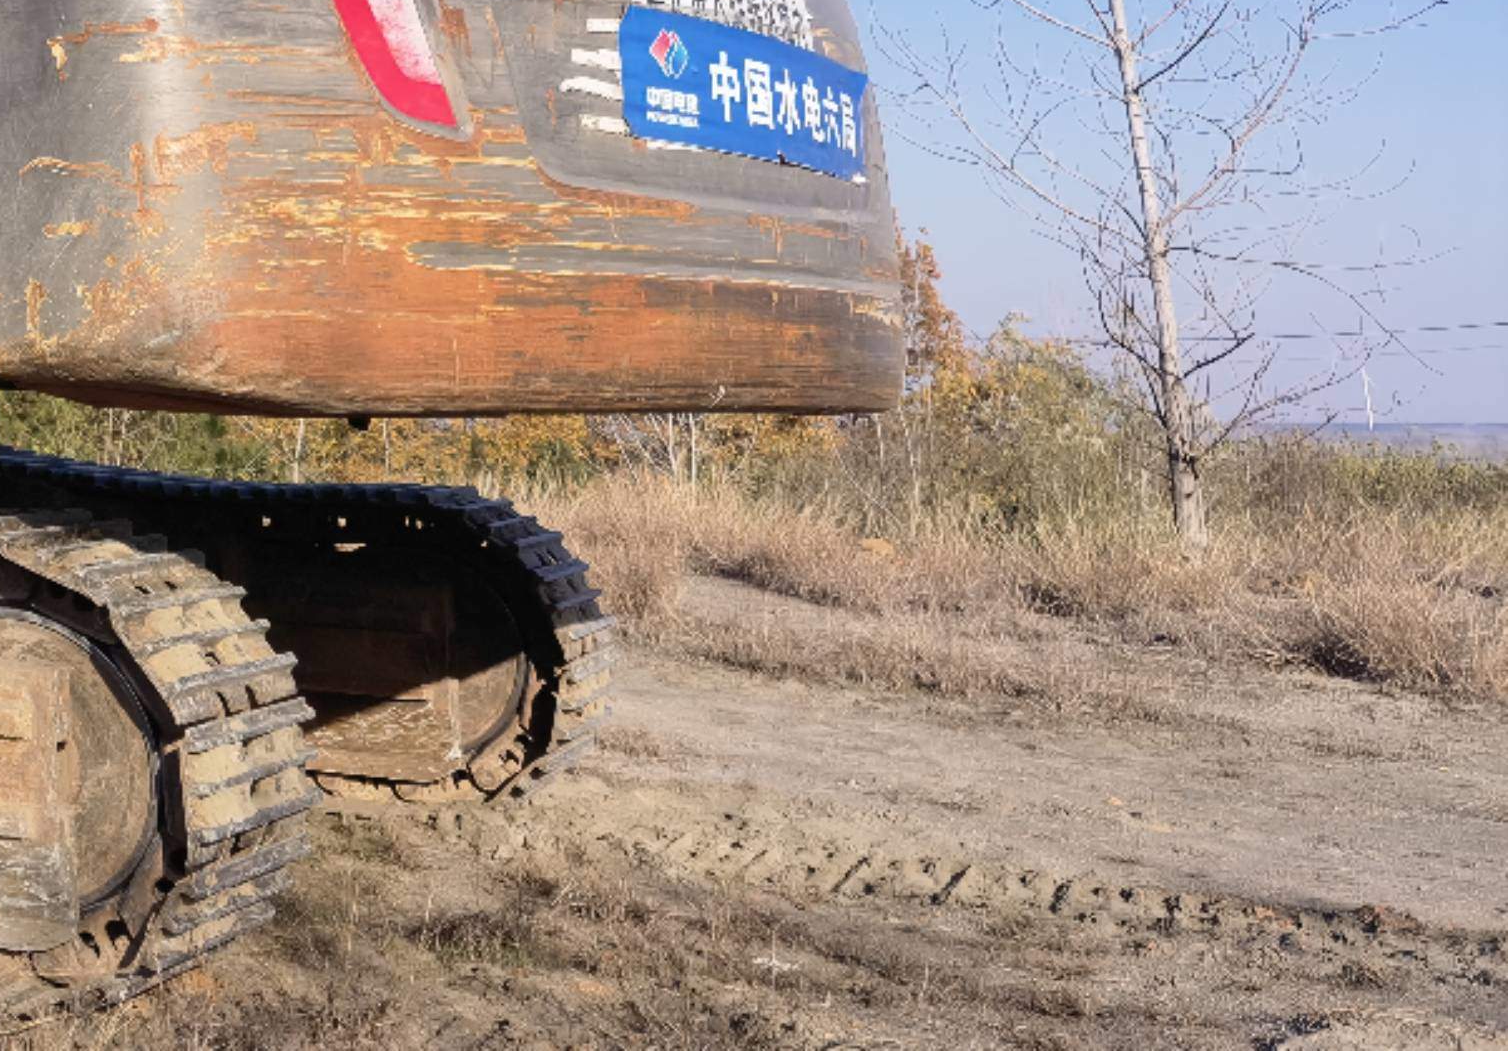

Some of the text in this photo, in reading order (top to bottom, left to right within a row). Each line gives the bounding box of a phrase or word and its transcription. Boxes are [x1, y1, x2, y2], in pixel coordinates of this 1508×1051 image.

[708, 50, 856, 157] 中国水电六局
